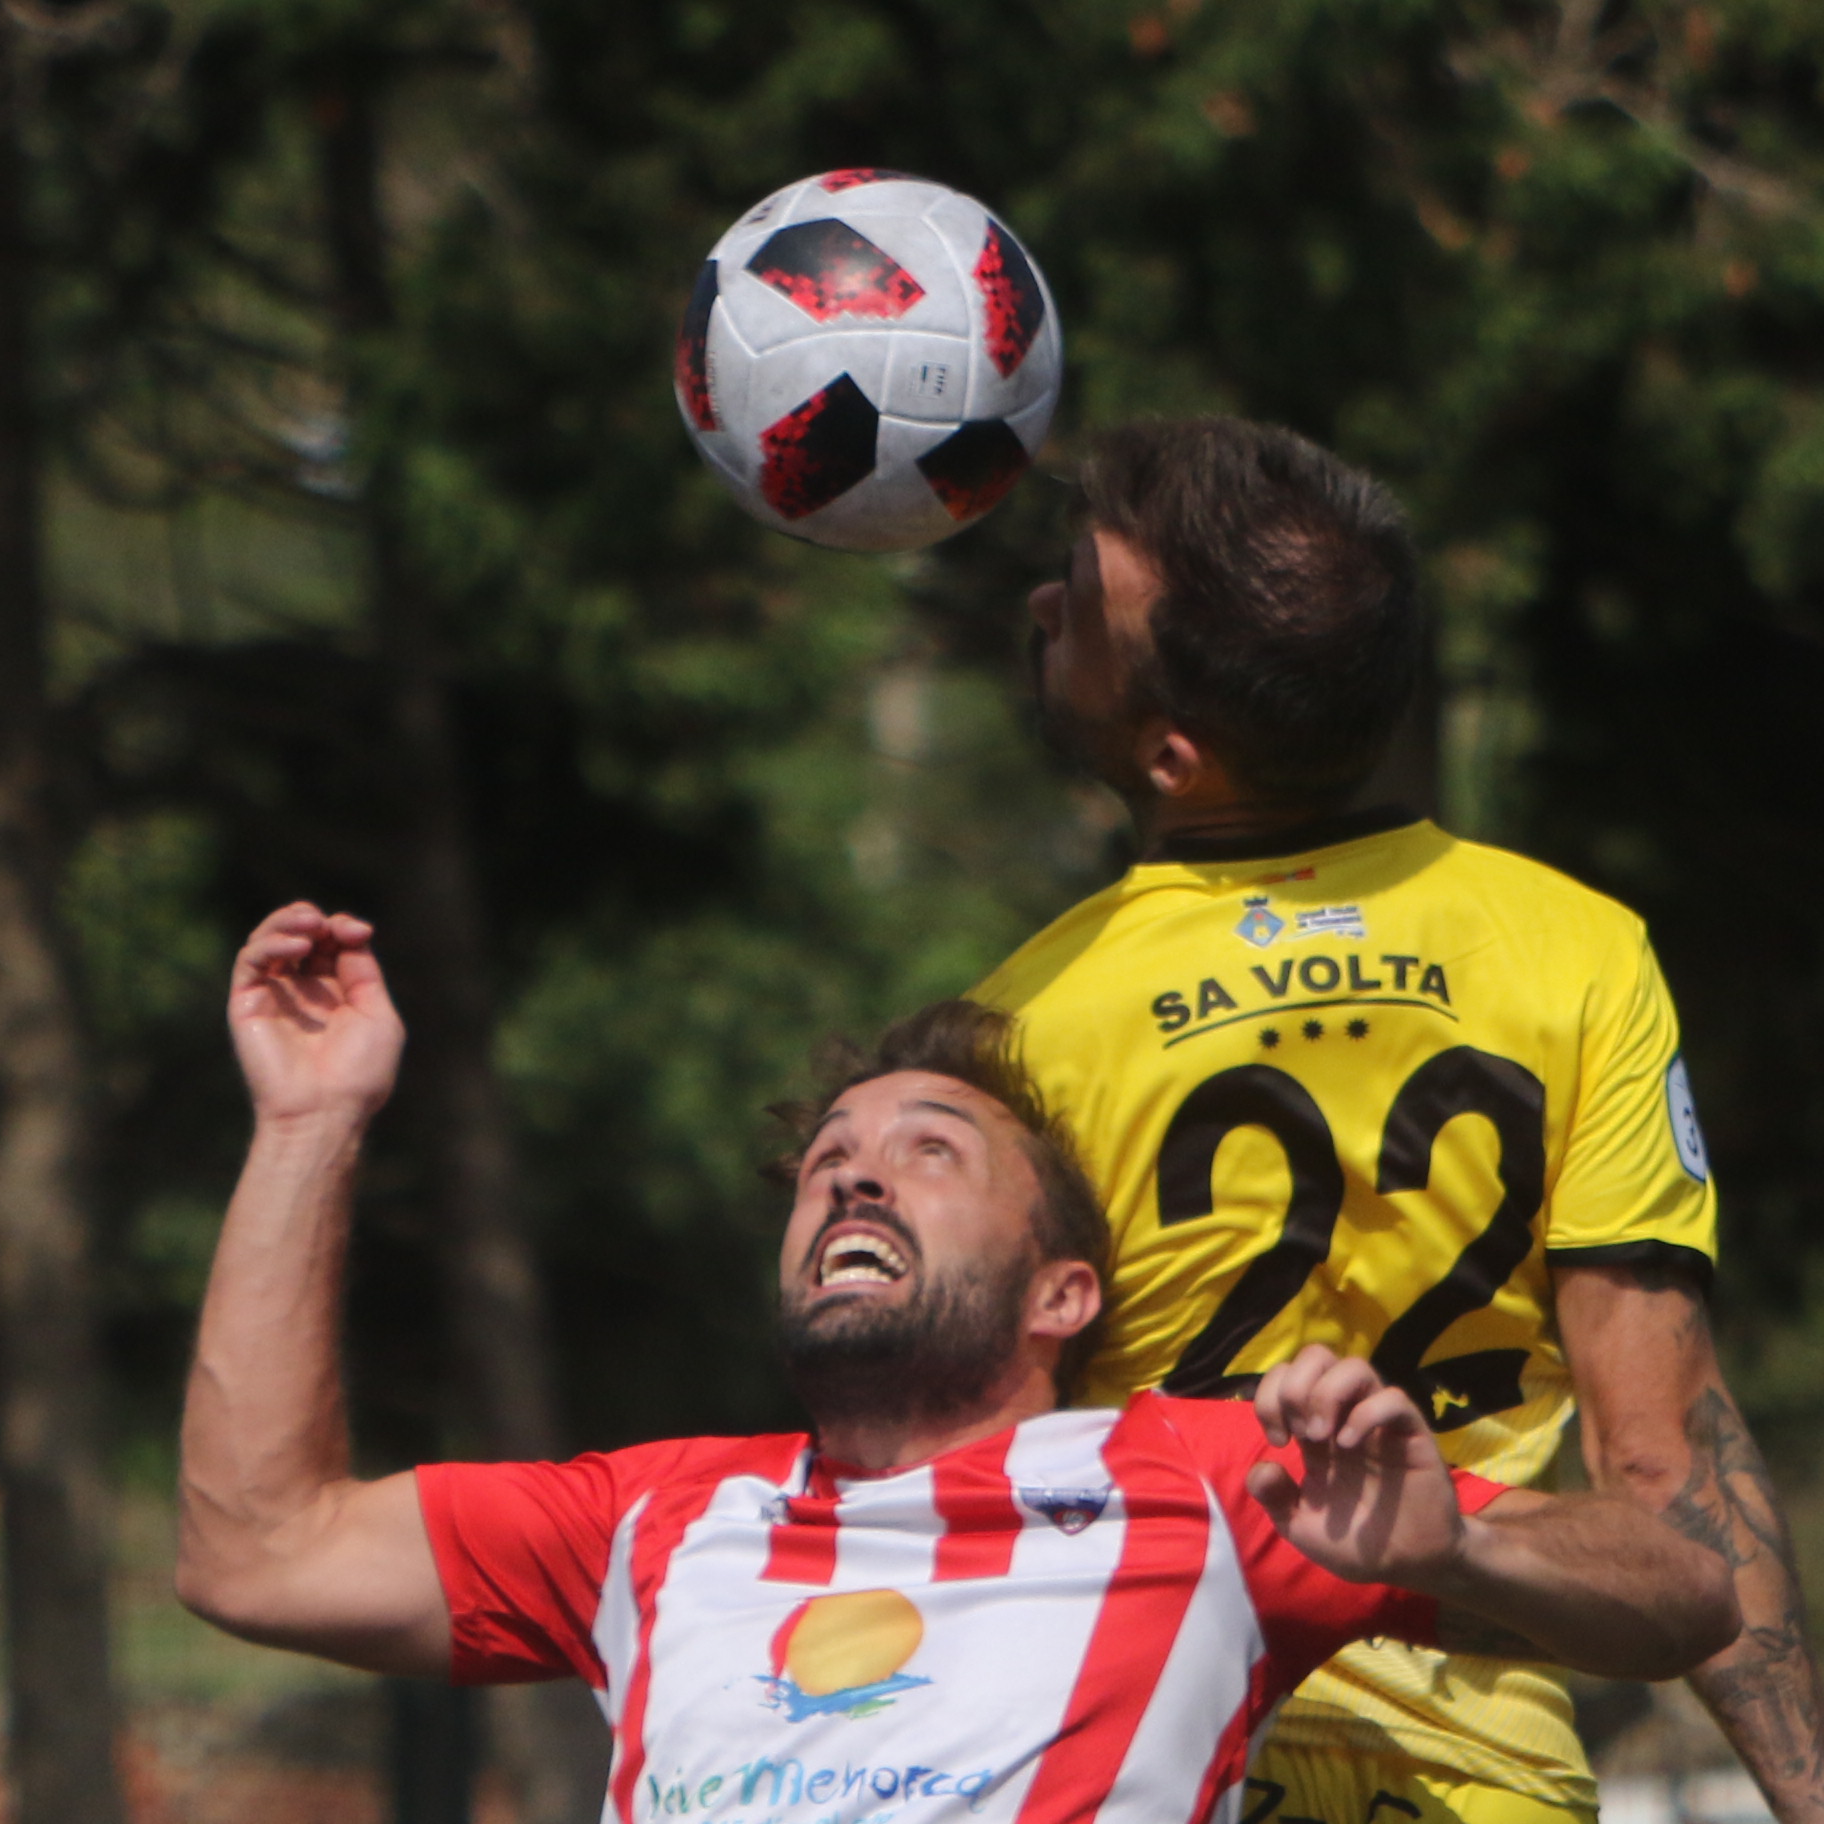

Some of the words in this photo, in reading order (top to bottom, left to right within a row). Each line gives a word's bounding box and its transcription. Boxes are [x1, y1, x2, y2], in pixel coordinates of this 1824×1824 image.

[1151, 976, 1239, 1033] SA
[1249, 954, 1452, 1006] VOLTA
[1156, 1044, 1548, 1433] 22
